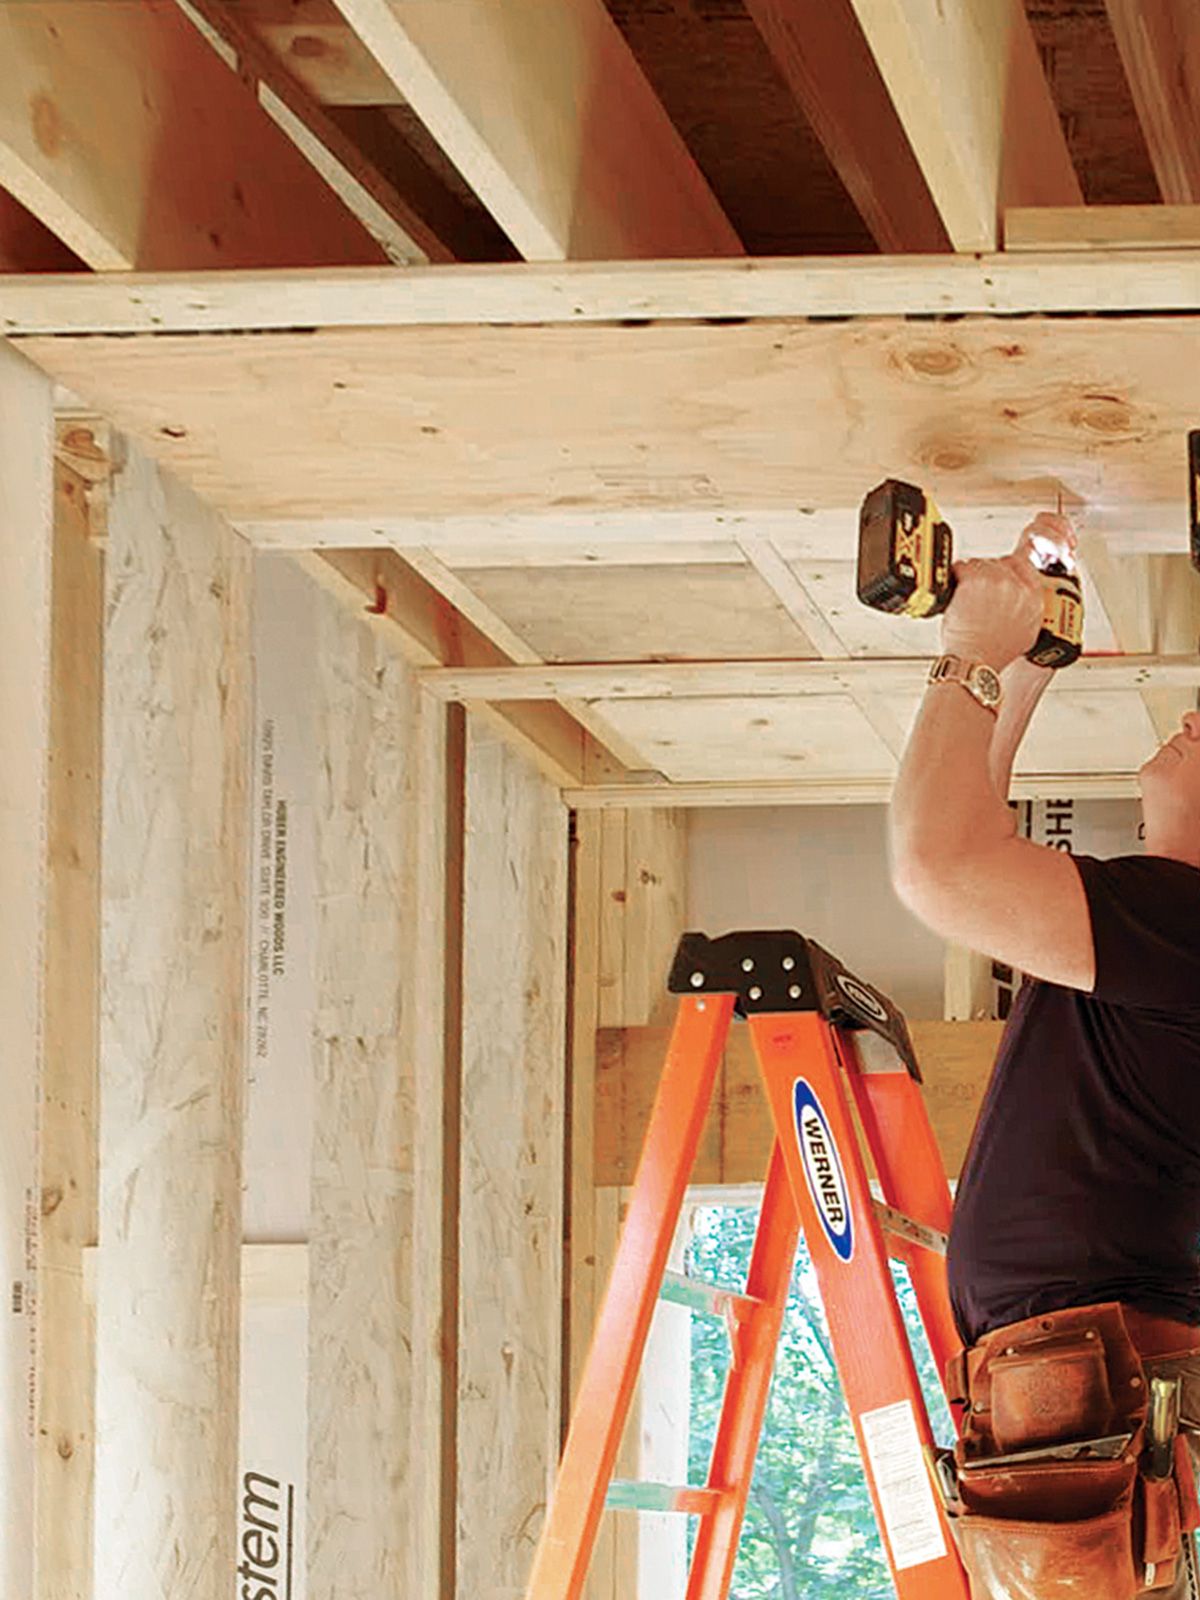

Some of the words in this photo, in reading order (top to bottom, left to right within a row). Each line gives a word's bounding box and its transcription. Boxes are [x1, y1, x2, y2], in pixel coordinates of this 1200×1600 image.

[272, 912, 285, 951] WOODS
[272, 954, 284, 975] LLC
[804, 1117, 844, 1223] WERNER
